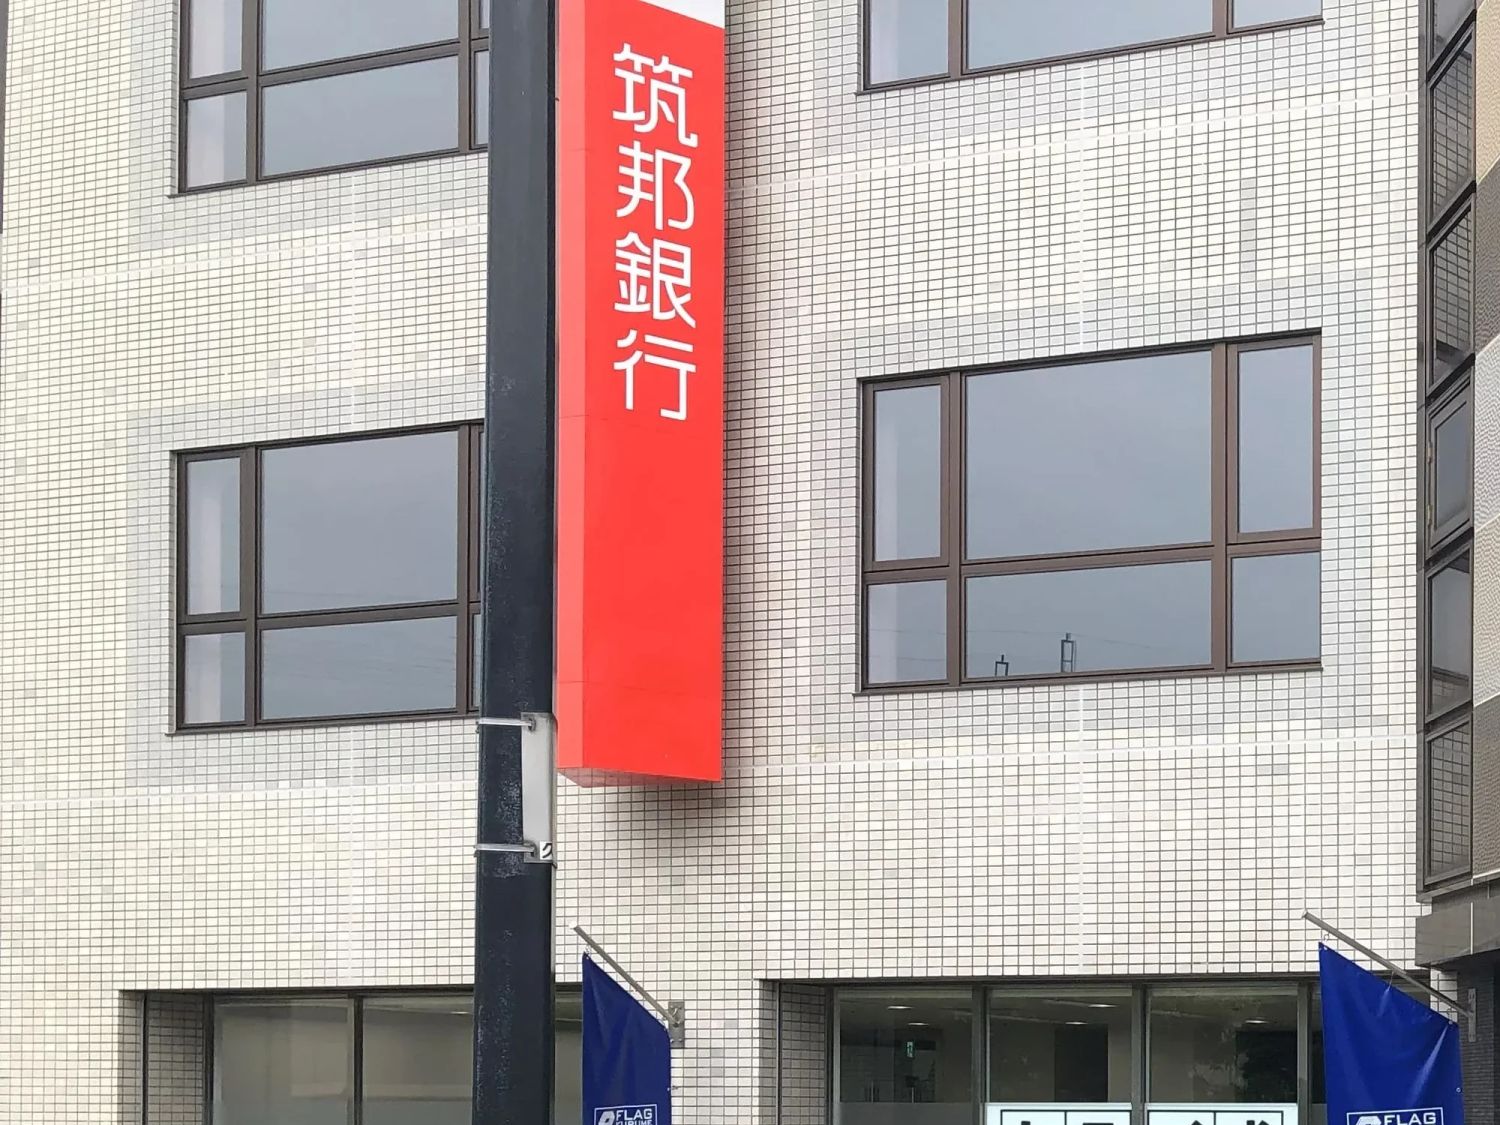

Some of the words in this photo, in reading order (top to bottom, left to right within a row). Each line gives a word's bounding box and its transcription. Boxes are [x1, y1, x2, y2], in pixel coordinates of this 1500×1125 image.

[612, 43, 698, 421] 筑邦銀行
[616, 1108, 653, 1121] FLAG
